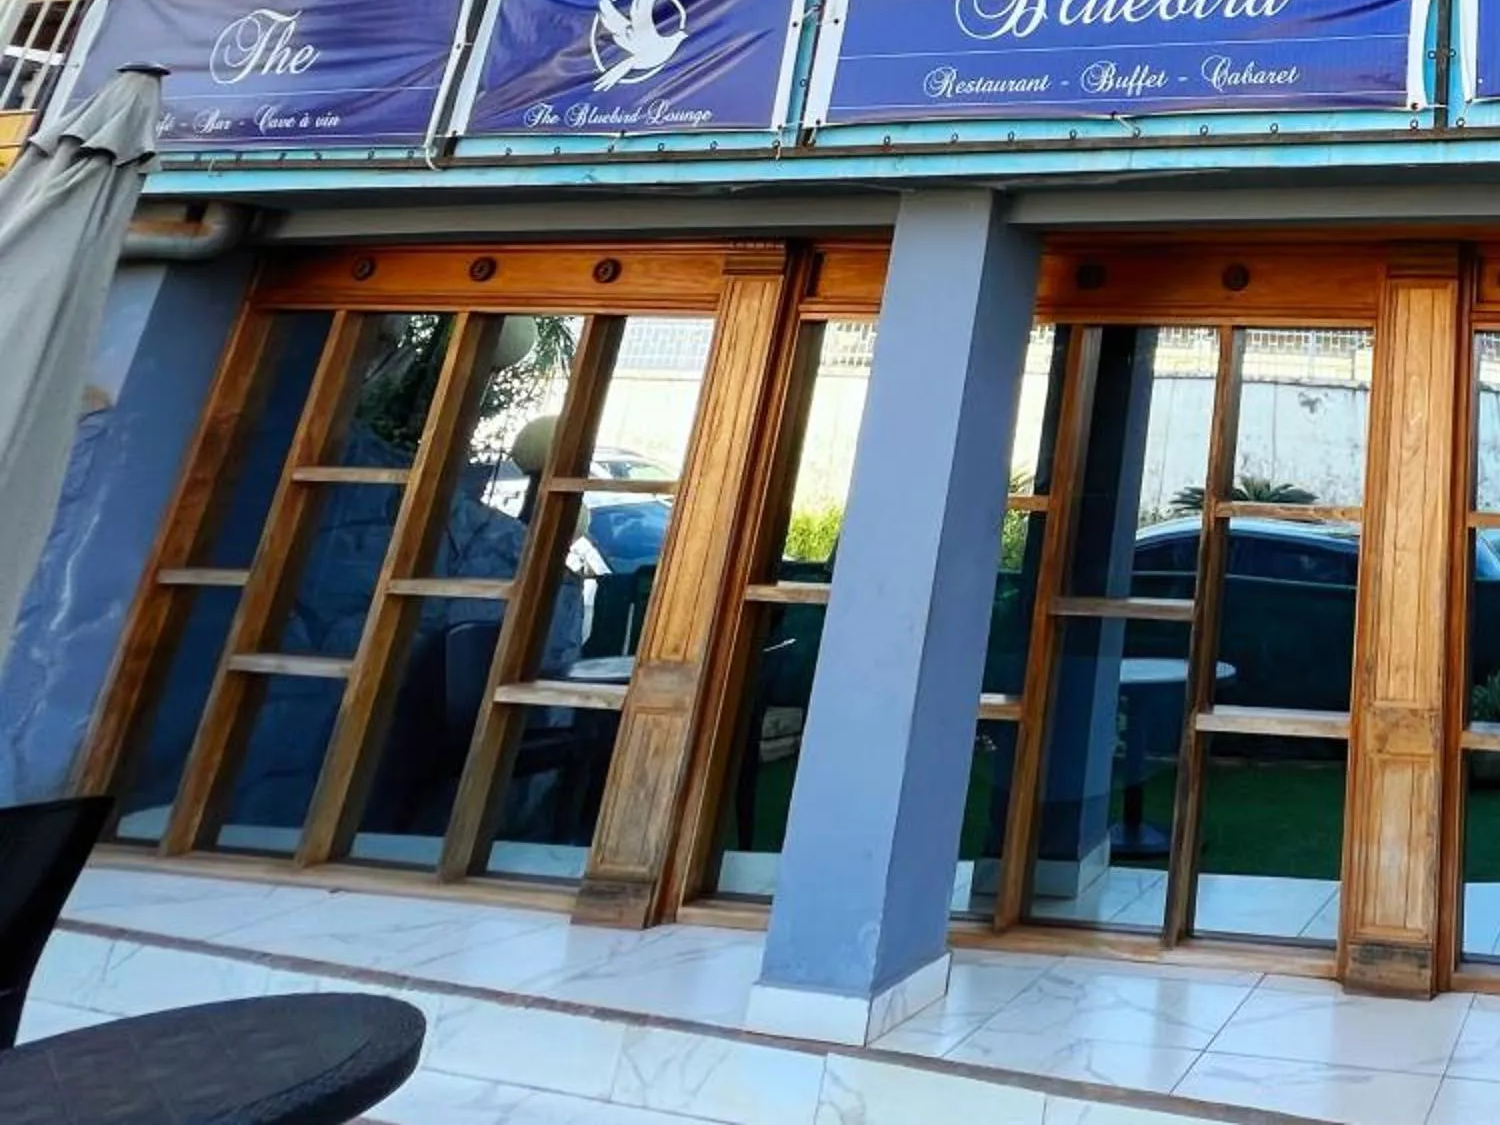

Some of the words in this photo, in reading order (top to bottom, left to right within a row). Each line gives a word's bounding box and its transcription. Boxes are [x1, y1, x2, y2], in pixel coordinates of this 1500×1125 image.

[209, 8, 321, 84] The
[923, 66, 1051, 98] Restaurant
[1080, 60, 1169, 97] Buffet
[1201, 54, 1301, 92] Cabaret
[192, 106, 232, 135] Bar
[254, 103, 295, 135] Cave
[298, 112, 309, 128] à
[315, 110, 340, 128] vin
[523, 102, 560, 129] The
[564, 102, 645, 130] Bluebird
[645, 98, 713, 127] Lounge
